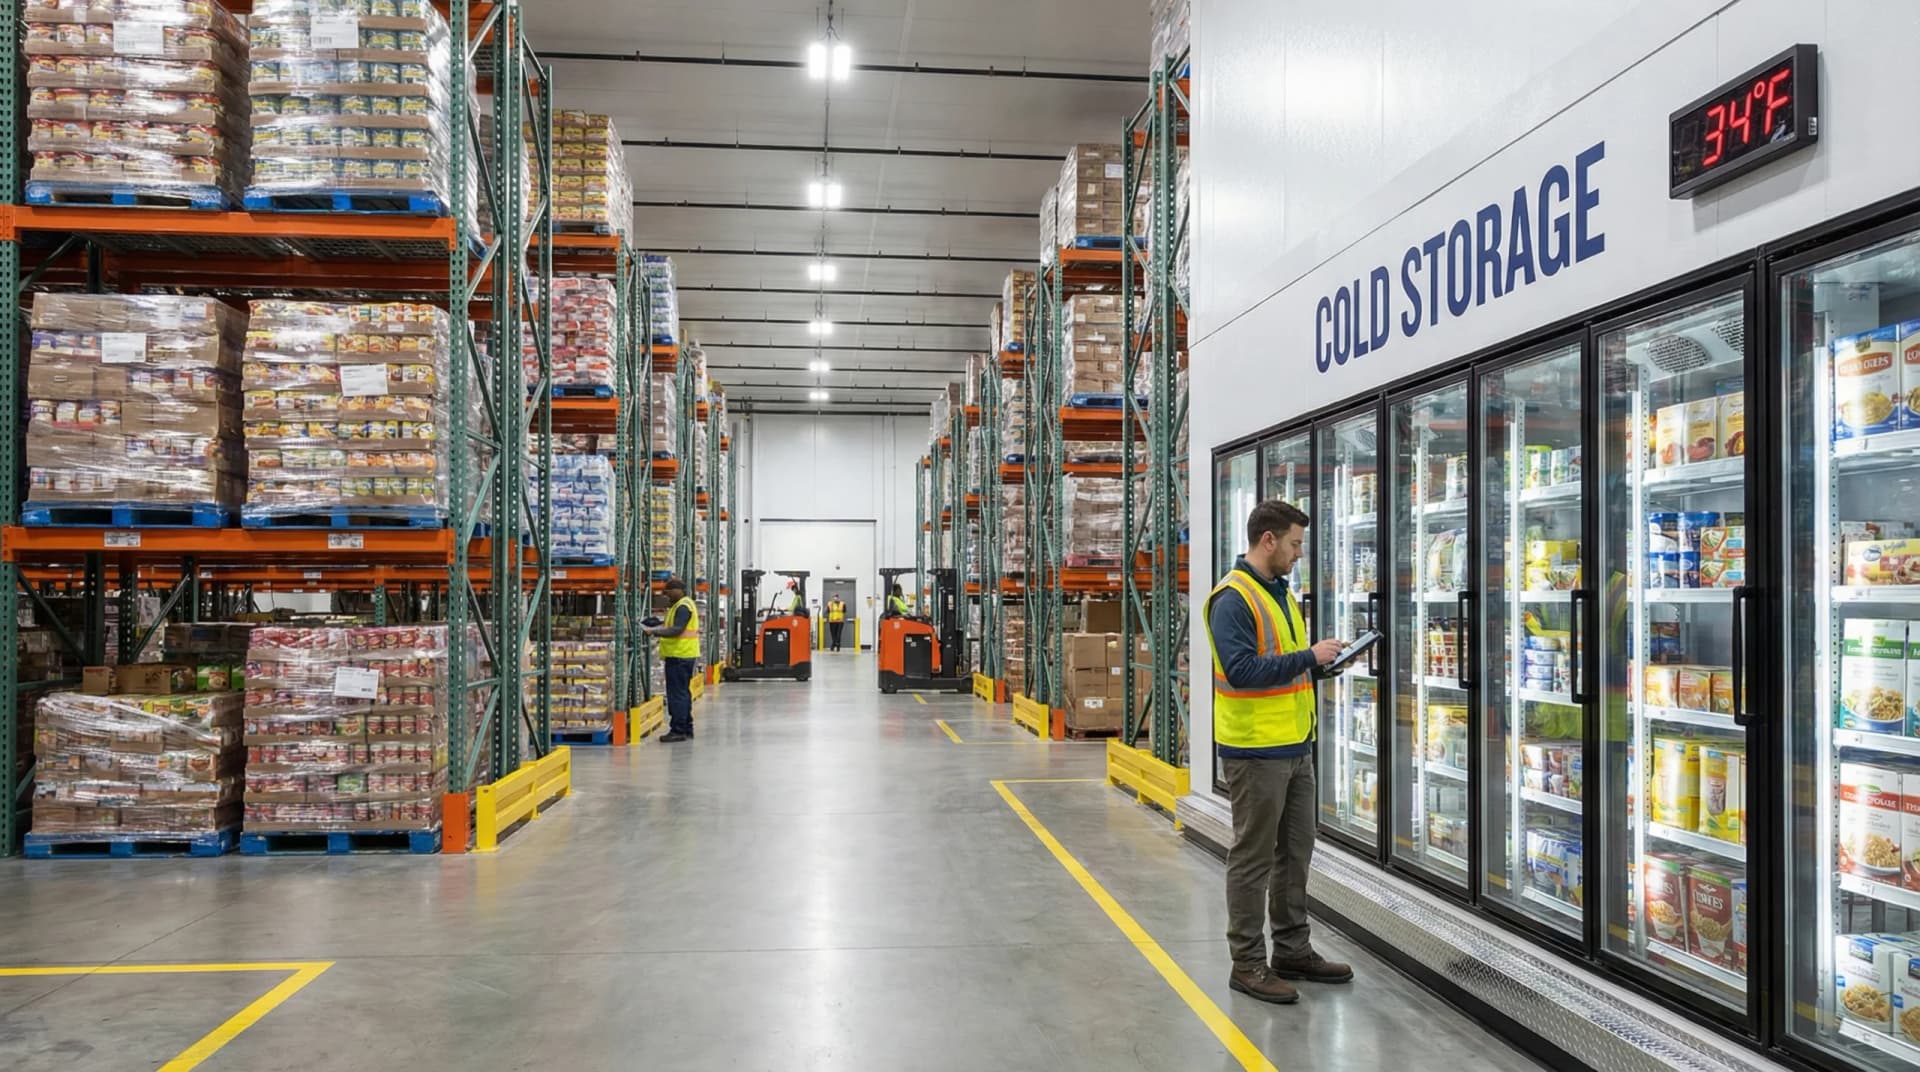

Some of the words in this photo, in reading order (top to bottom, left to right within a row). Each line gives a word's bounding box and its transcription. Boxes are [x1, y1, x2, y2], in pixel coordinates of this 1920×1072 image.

[1703, 68, 1791, 166] 34°F
[1316, 266, 1390, 373] COLD
[1401, 140, 1605, 338] STORAGE
